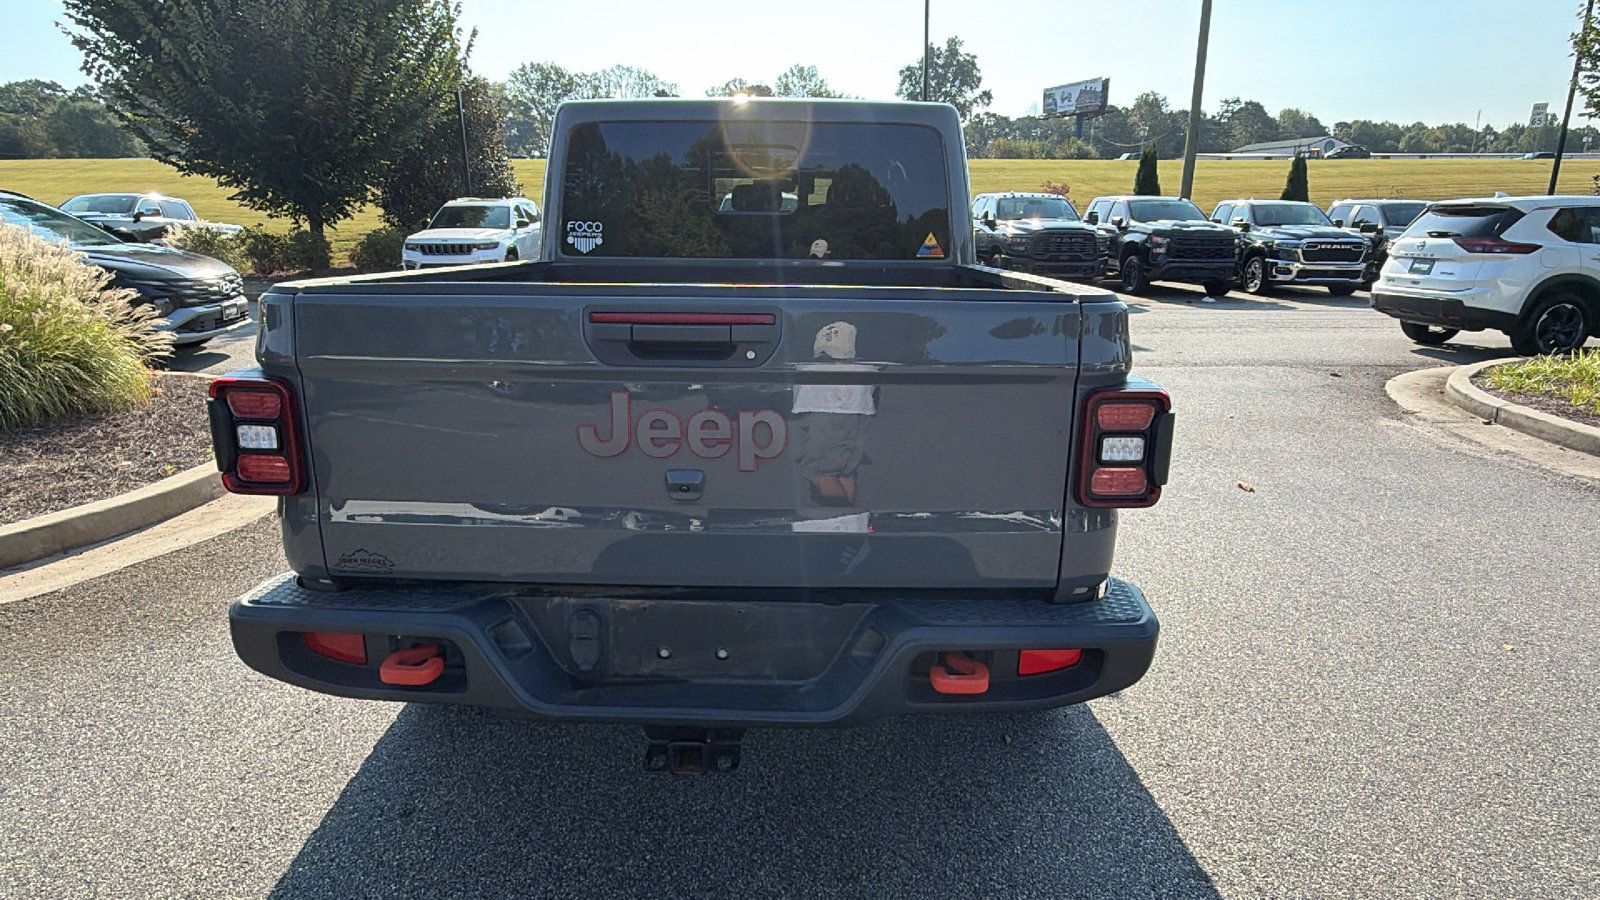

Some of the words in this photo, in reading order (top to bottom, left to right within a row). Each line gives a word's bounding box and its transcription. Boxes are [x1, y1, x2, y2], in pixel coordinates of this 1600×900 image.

[1532, 117, 1542, 125] 65
[567, 221, 603, 231] FOCO
[577, 390, 788, 472] Jeep
